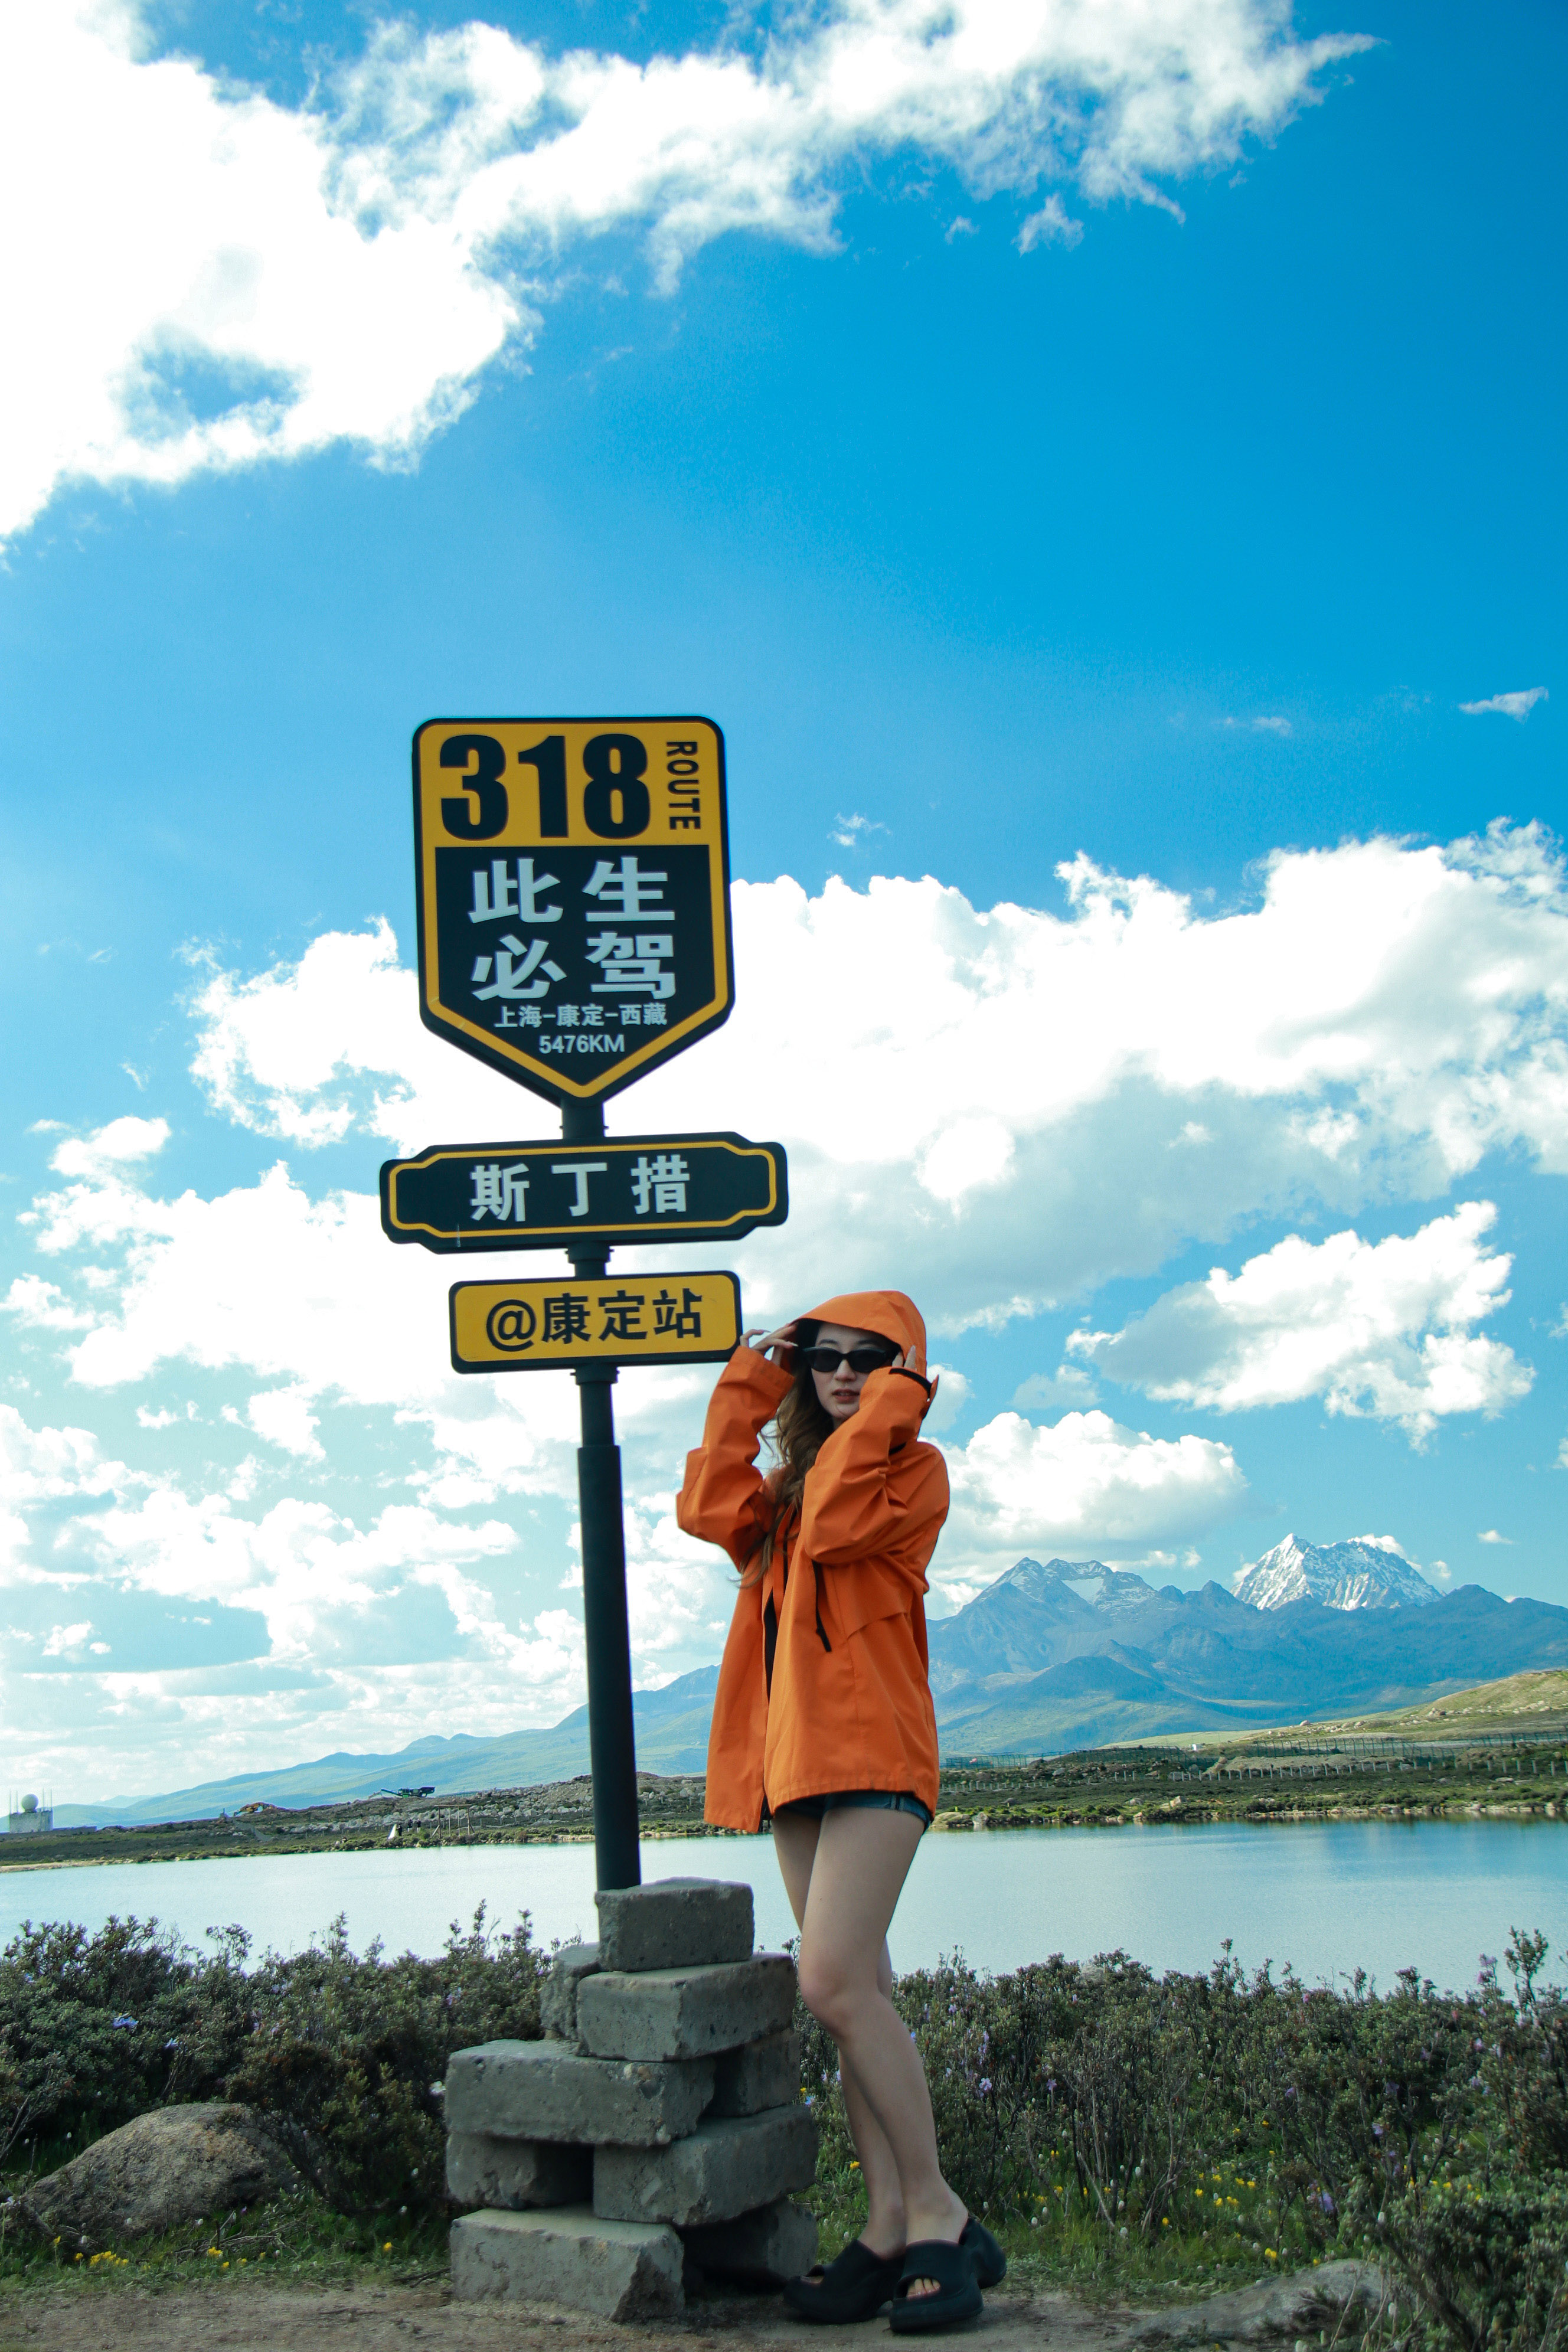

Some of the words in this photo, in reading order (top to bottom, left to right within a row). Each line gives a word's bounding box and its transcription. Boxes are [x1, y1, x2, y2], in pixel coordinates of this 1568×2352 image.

[439, 733, 650, 841] 318
[666, 741, 701, 830] ROUTE
[468, 856, 675, 923] 此生
[471, 931, 677, 1001] 必驾
[538, 1034, 625, 1054] 5476KM
[469, 1154, 690, 1223] 斯丁措
[486, 1288, 703, 1351] @康定站
